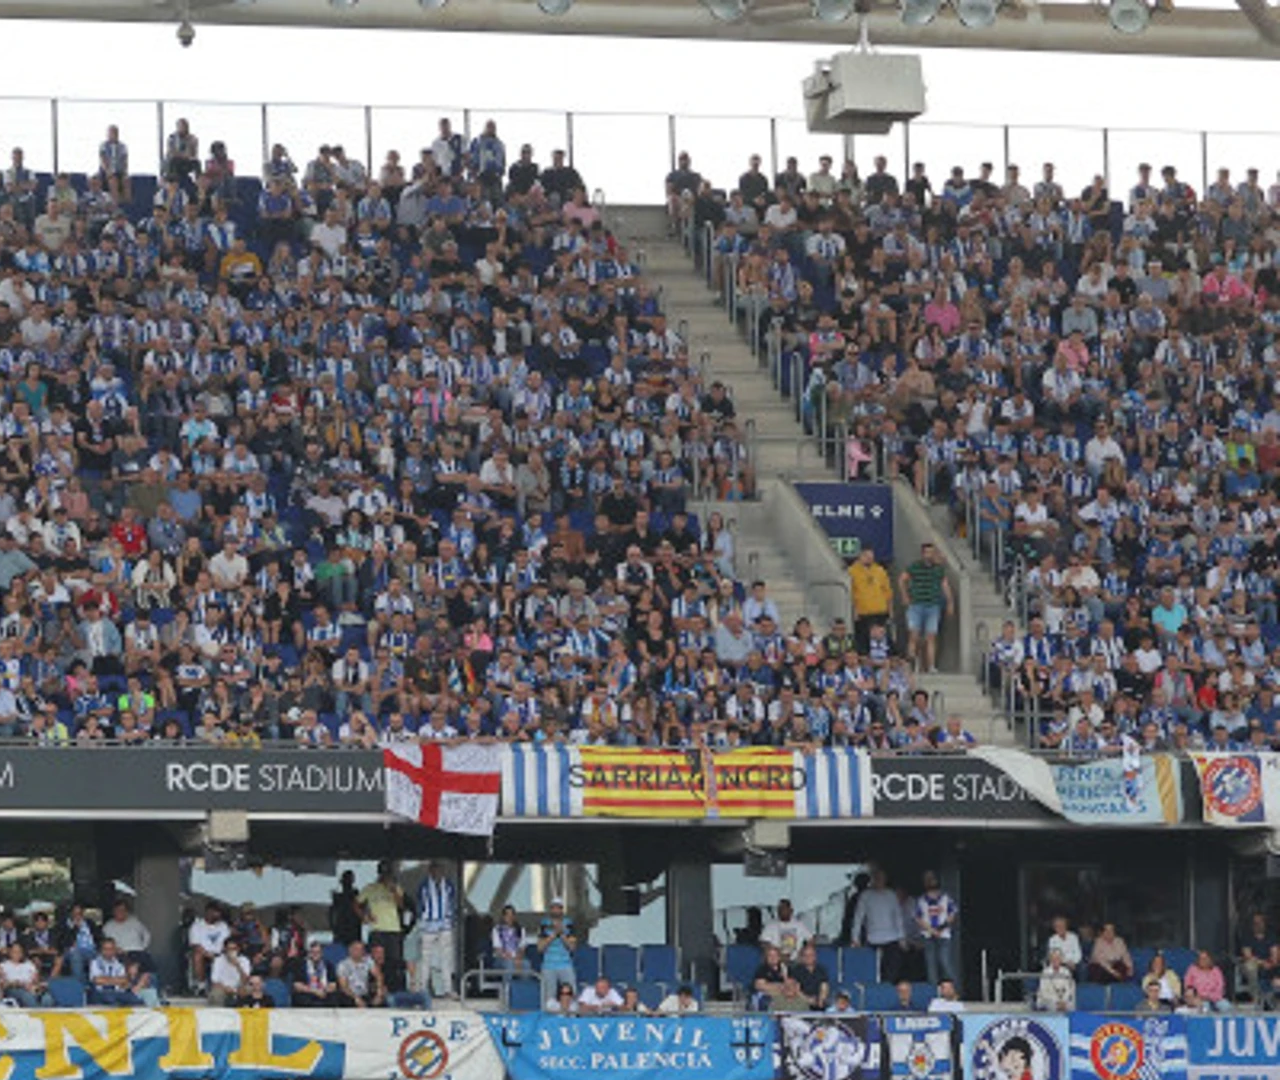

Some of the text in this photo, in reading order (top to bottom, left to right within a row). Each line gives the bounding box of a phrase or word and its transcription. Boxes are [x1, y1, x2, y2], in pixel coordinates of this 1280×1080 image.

[167, 763, 249, 791] RCDE
[539, 1022, 711, 1051] JUVENIL
[590, 1052, 713, 1070] PALENCIA
